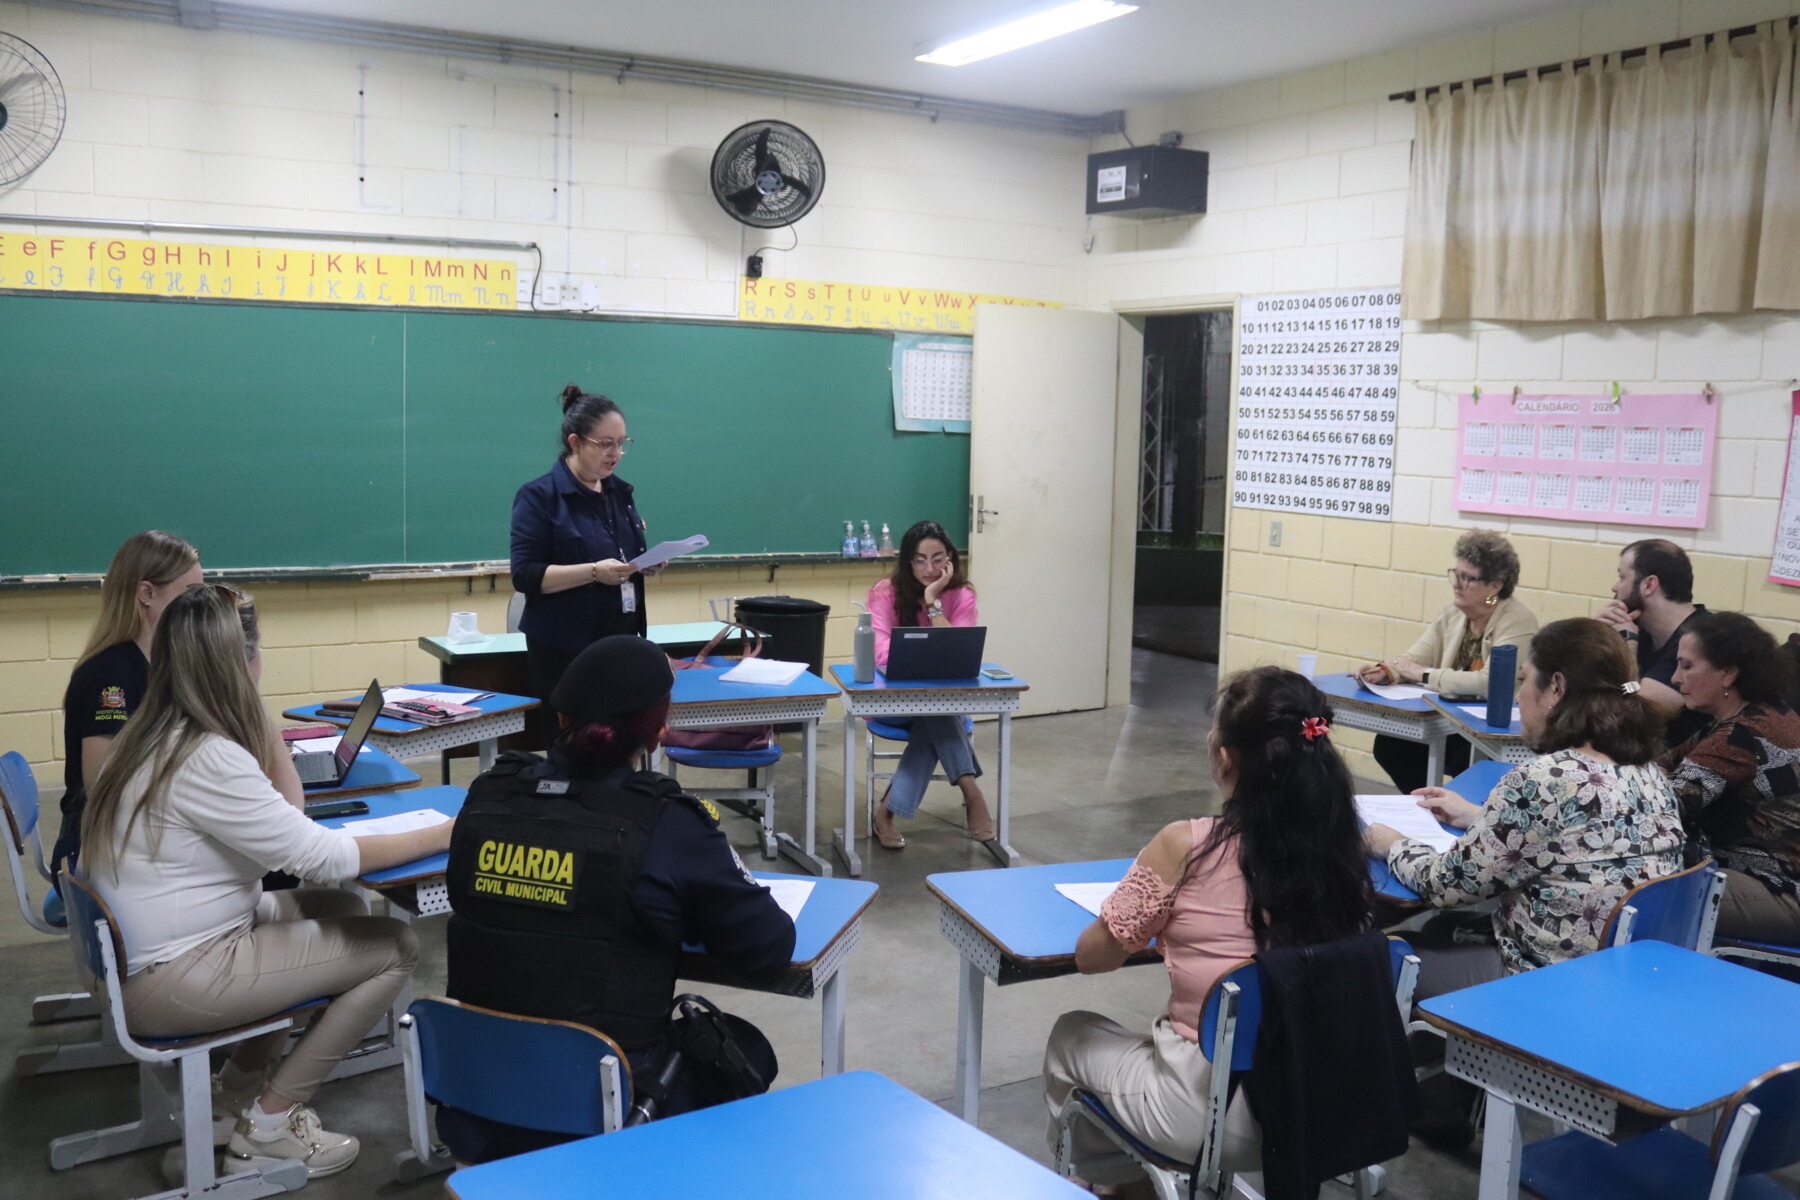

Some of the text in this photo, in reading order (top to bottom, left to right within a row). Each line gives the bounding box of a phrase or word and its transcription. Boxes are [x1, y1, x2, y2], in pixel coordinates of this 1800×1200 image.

[1258, 293, 1401, 311] 01 02 03 04 05 06 07 08 09
[1242, 317, 1400, 333] 10 11 12 13 14 15 16 17 18 19
[1242, 340, 1399, 354] 20 21 22 23 24 25 26 27 28 29
[1241, 364, 1398, 376] 30 31 32 33 34 35 36 37 38 39
[1240, 386, 1396, 399] 40 41 42 43 44 45 46 47 48 49
[1517, 400, 1616, 412] CALENDÁRIO 2026
[1239, 408, 1395, 422] 50 51 52 53 54 55 56 57 58 59
[1238, 429, 1393, 446] 60 61 62 63 64 65 66 67 68 69
[1237, 450, 1392, 469] 70 71 72 73 74 75 76 77 78 79
[1236, 470, 1390, 492] 80 81 82 83 84 85 86 87 88 89
[1235, 492, 1390, 515] 90 91 92 93 94 95 96 97 98 99
[478, 840, 574, 884] GUARDA
[475, 877, 567, 905] CIVIL MUNICIPAL
